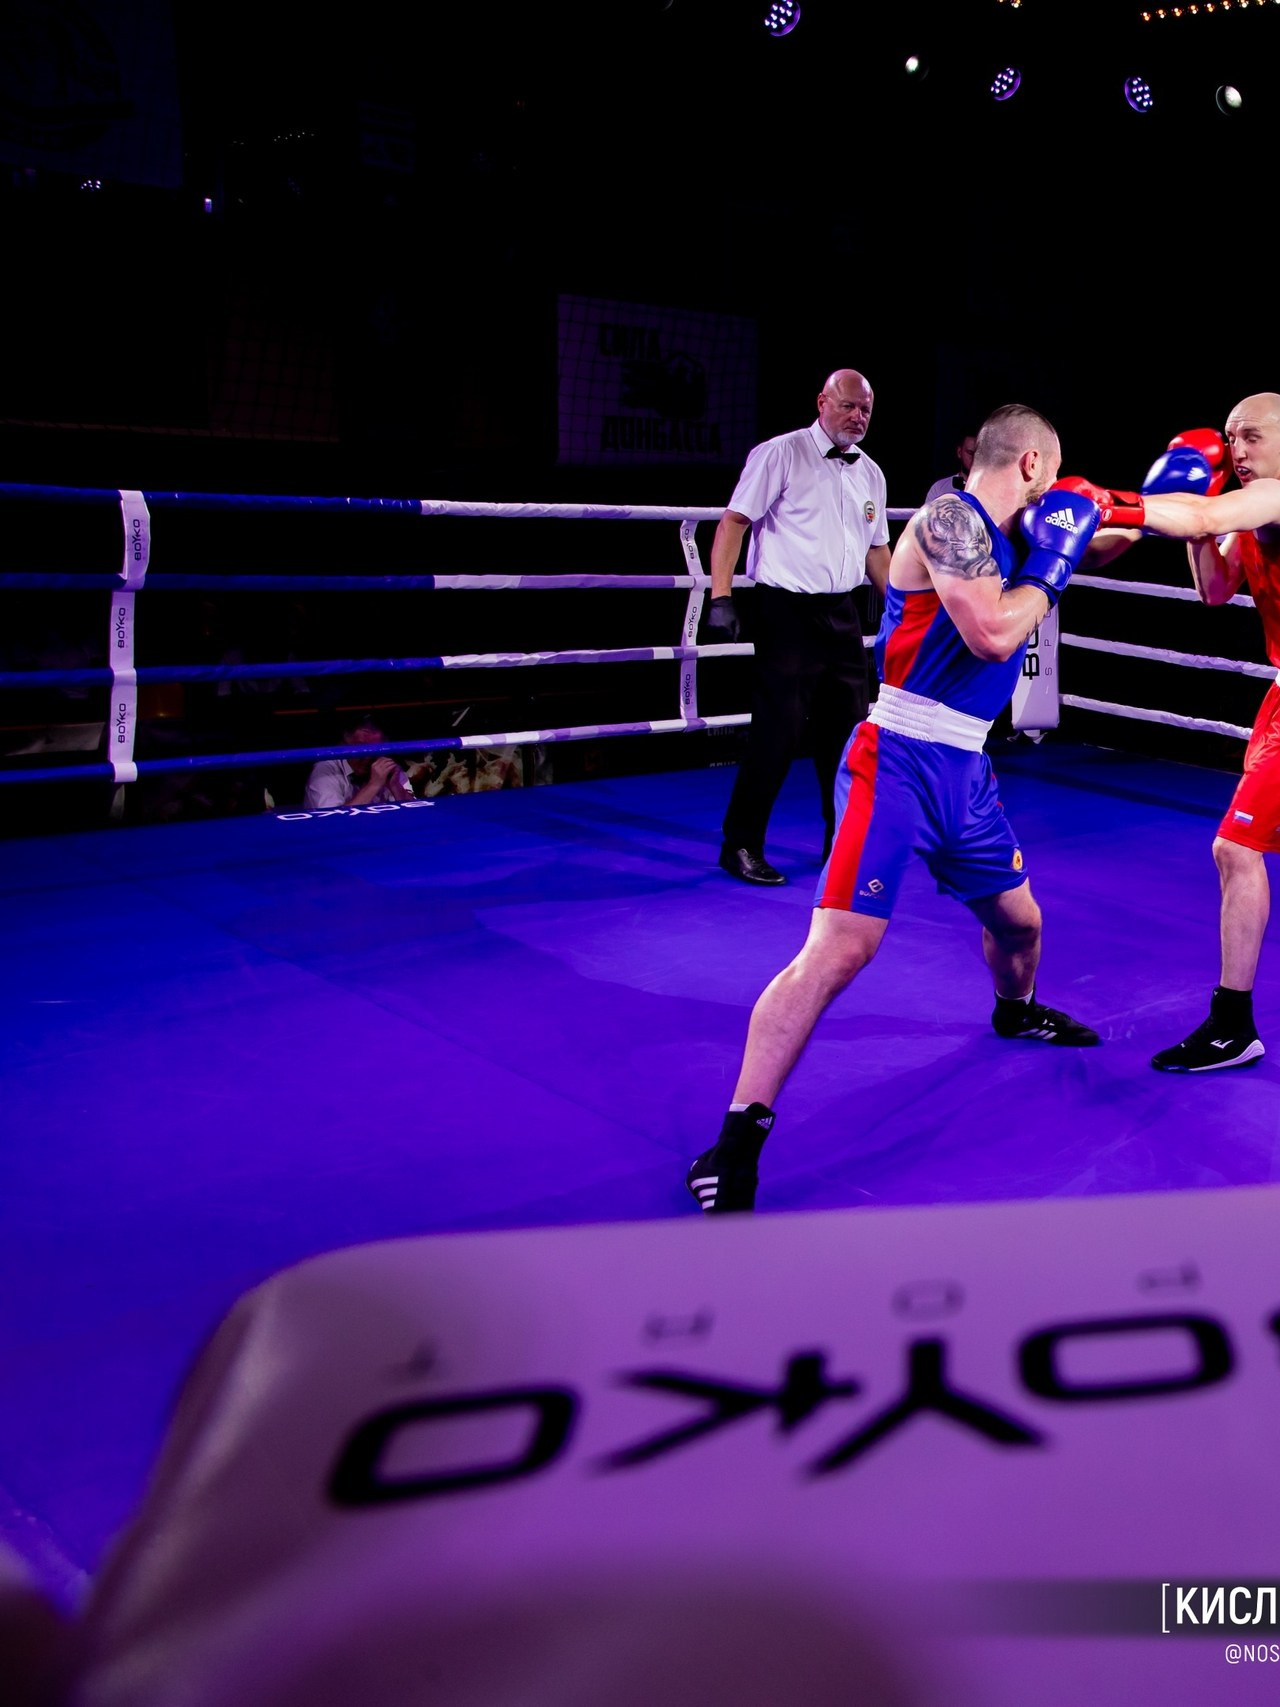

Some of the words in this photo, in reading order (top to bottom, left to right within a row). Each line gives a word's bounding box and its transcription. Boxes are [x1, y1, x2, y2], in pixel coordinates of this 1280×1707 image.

[602, 416, 722, 453] ДОНБАССА
[132, 519, 142, 561] BOYKO
[1045, 516, 1079, 534] adidas
[116, 607, 126, 649] BOYKO
[688, 606, 697, 638] BOYKO
[683, 673, 691, 705] BOYKO
[116, 703, 127, 744] BOYKO
